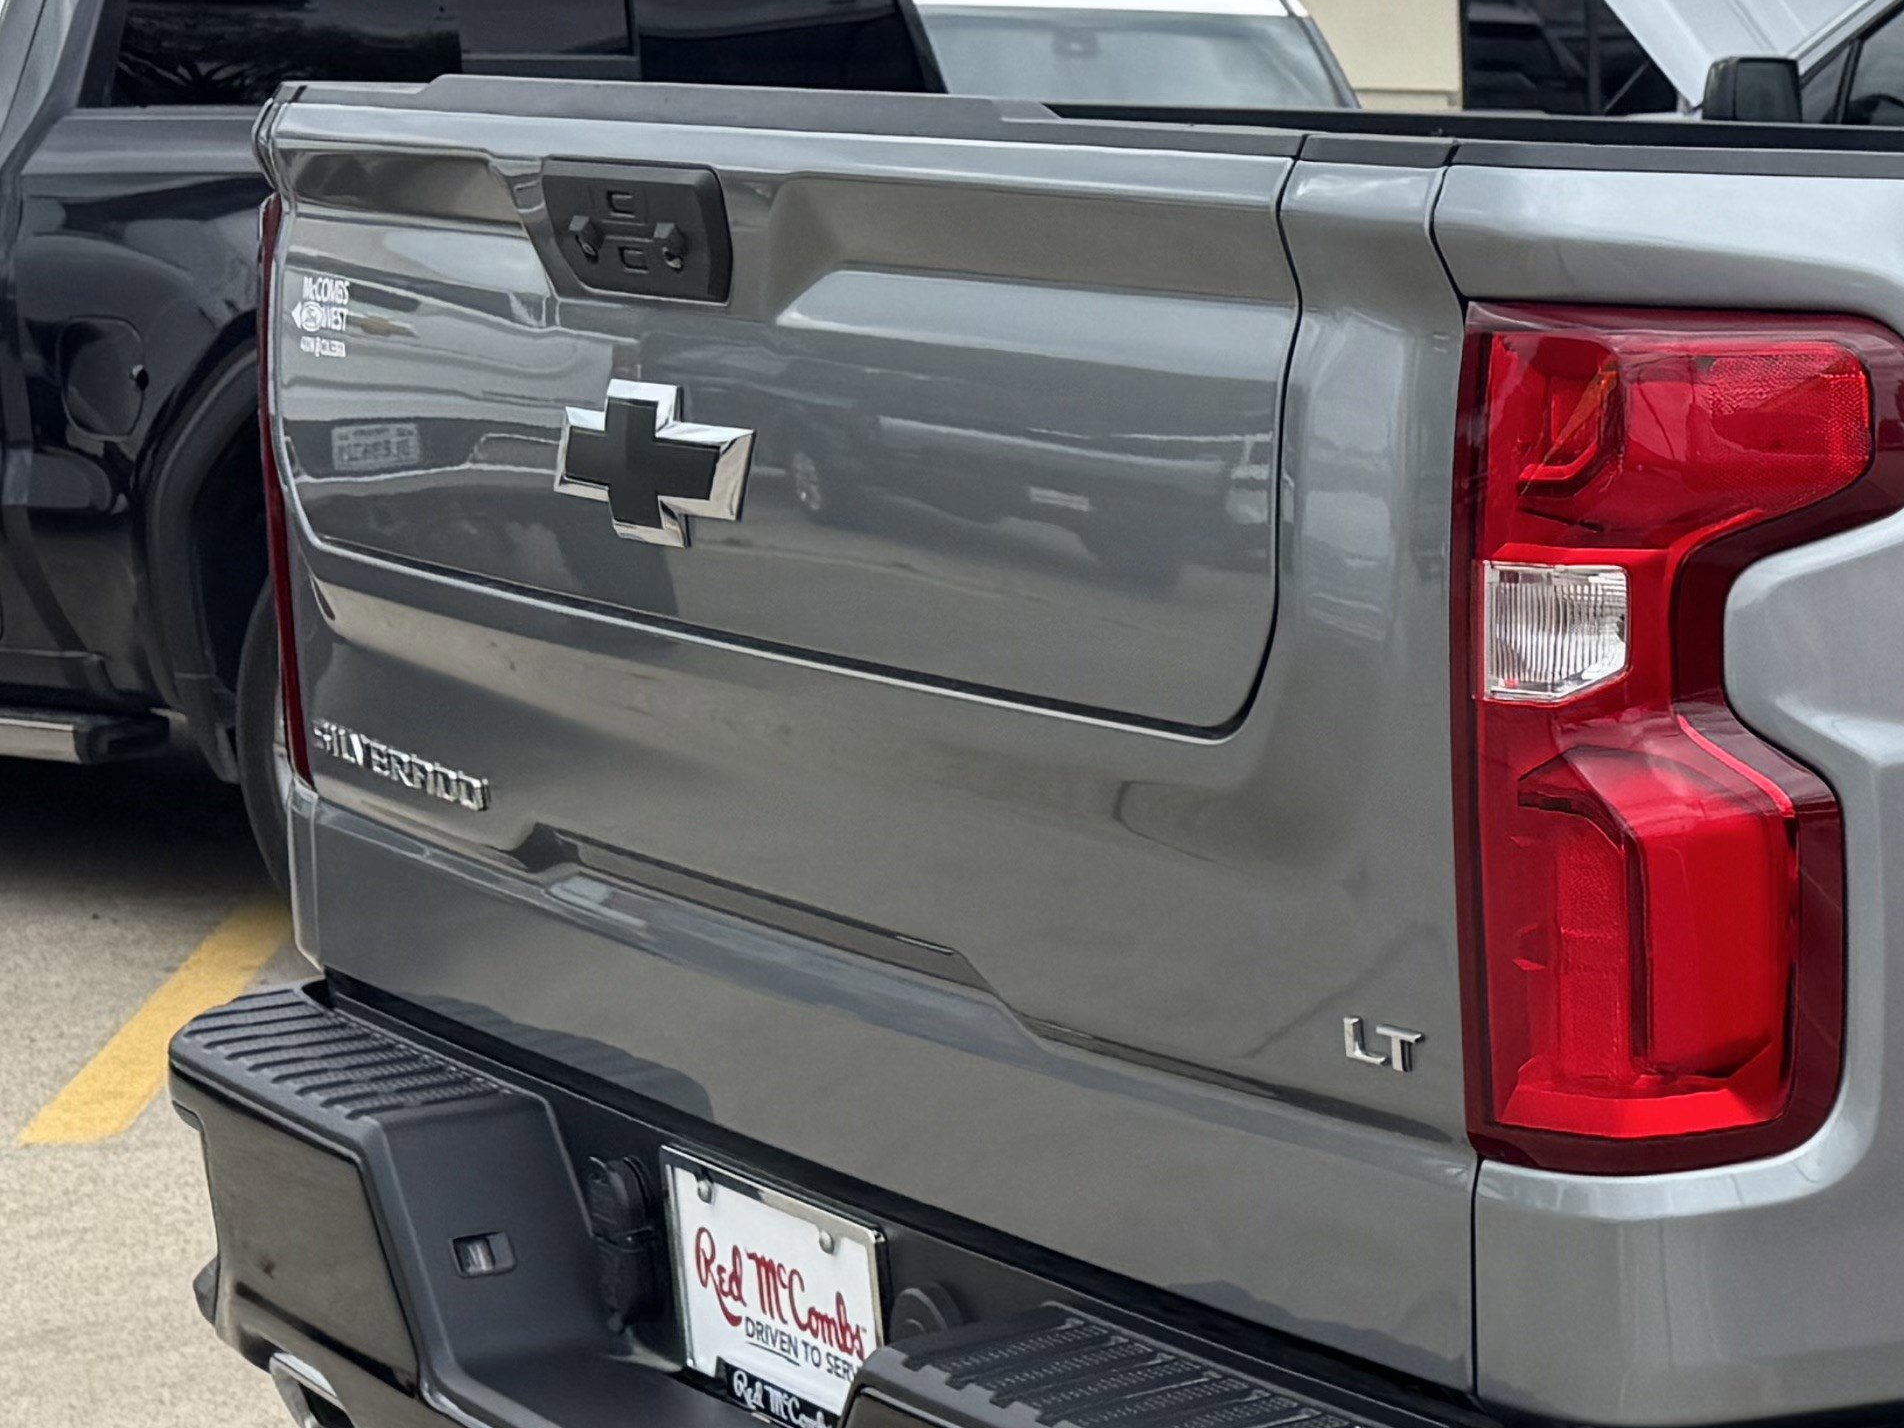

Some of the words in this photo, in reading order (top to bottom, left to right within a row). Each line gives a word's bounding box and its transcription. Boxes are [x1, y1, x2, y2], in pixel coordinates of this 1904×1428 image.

[312, 720, 490, 812] SILVERADO
[1343, 1016, 1424, 1072] LT
[695, 1226, 747, 1327] Red
[745, 1316, 799, 1359] DRIVEN
[801, 1340, 822, 1368] TO
